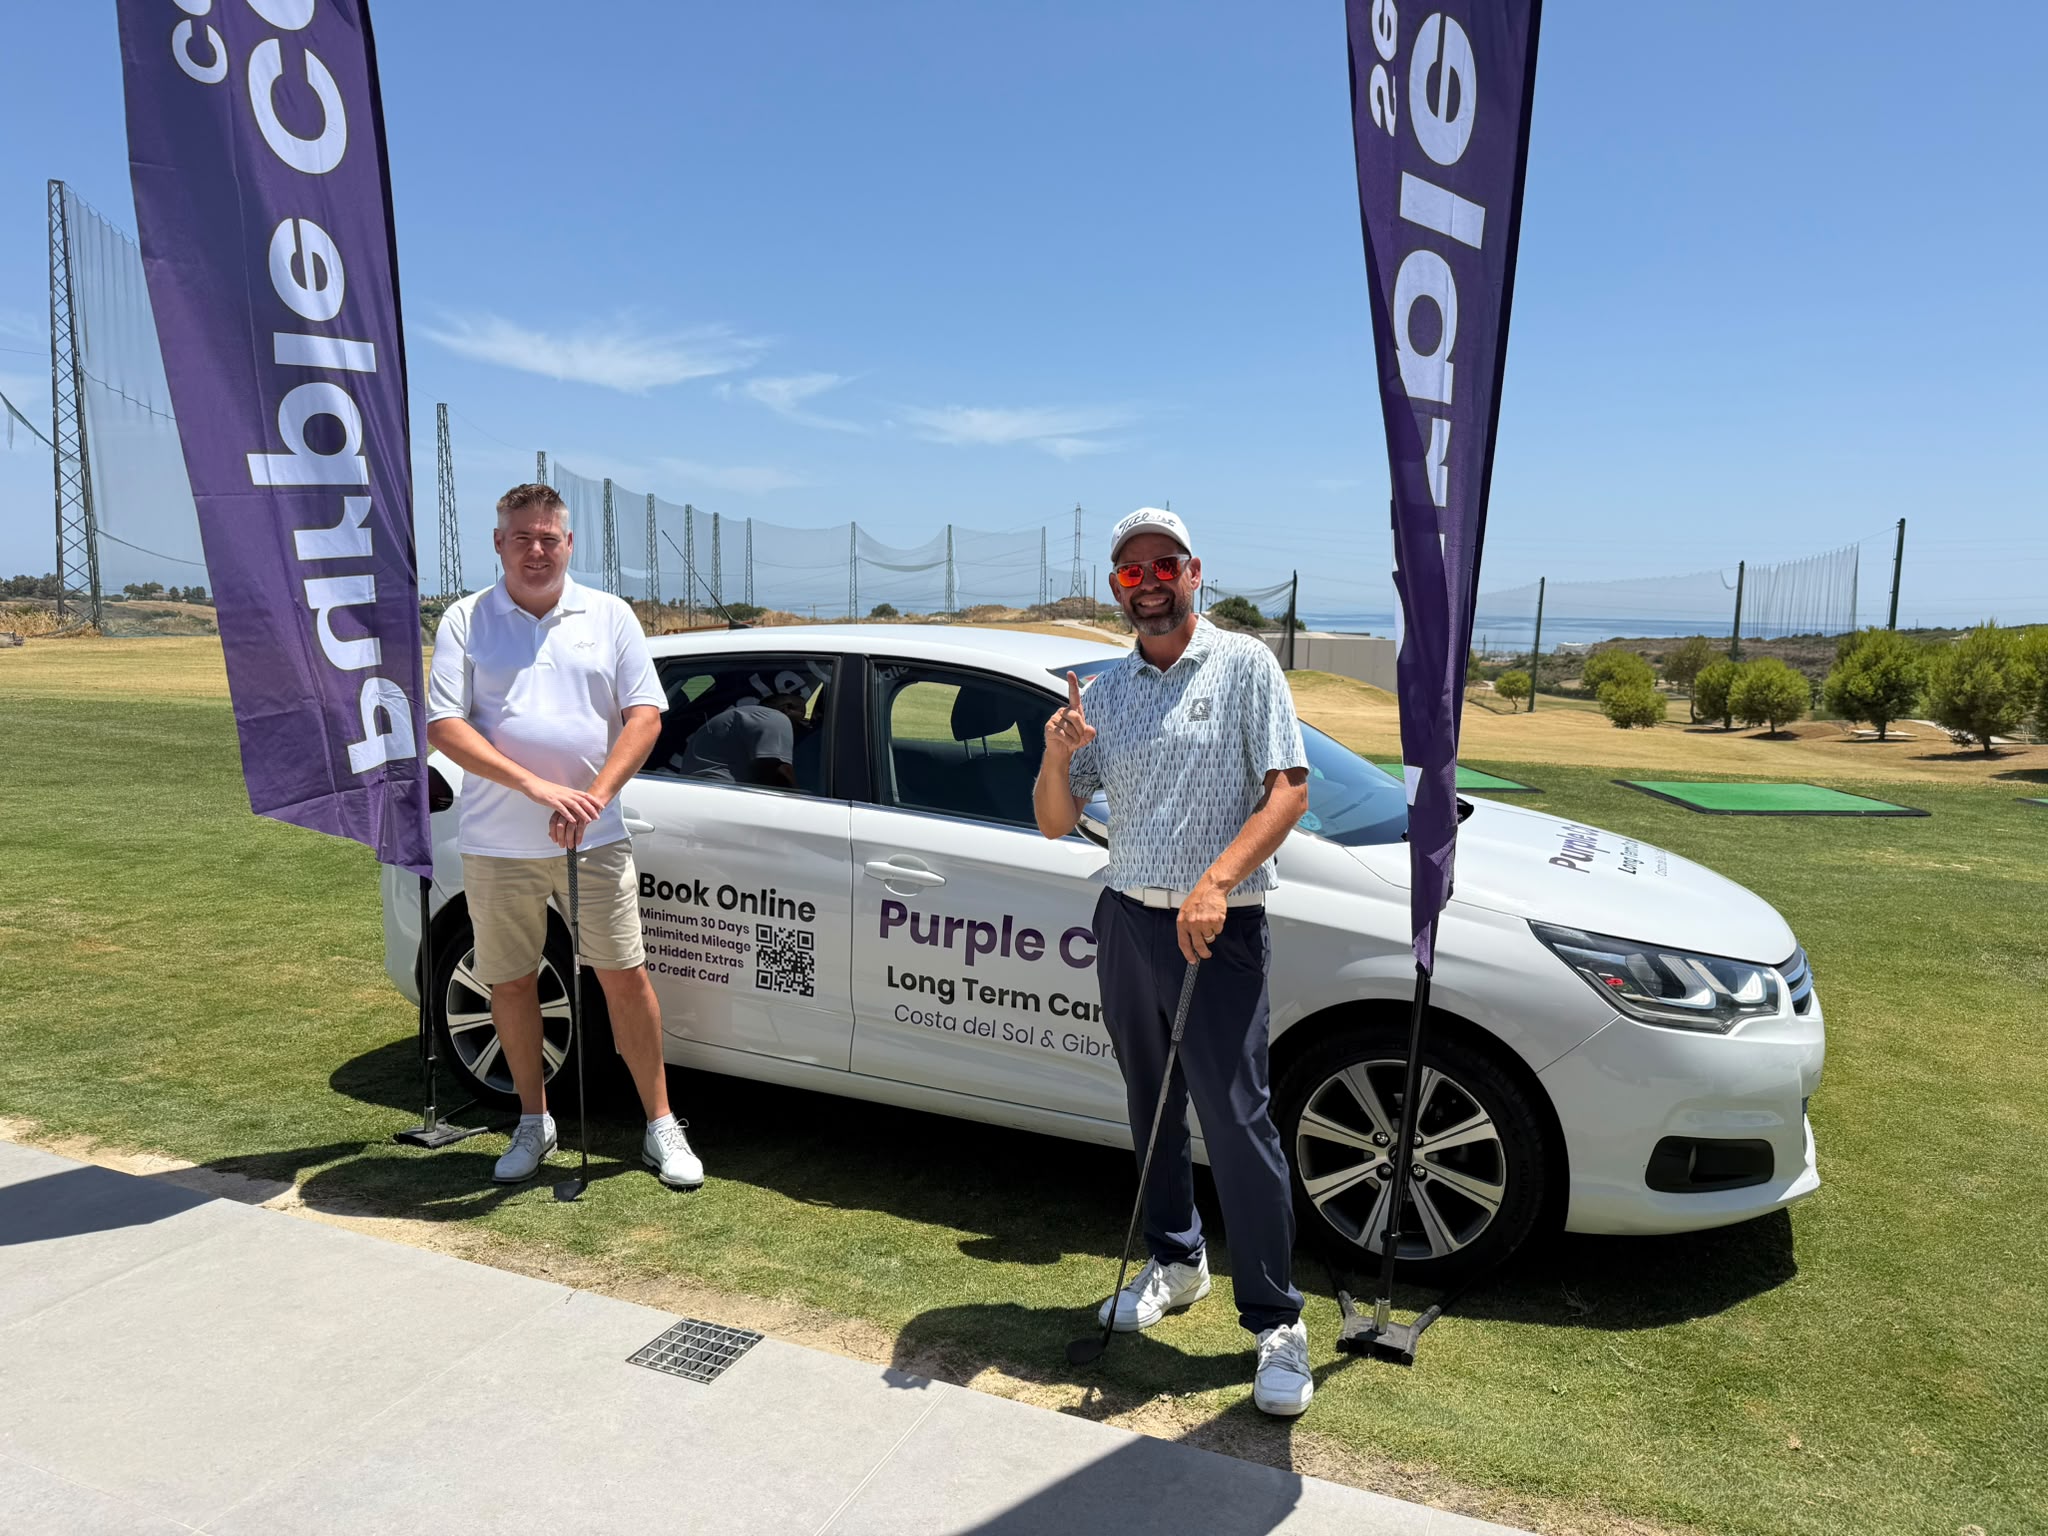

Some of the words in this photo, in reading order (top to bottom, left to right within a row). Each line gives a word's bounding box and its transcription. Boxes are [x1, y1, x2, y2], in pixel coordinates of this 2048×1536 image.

[639, 872, 710, 907] Book
[716, 884, 817, 924] Online
[640, 907, 698, 926] Minimum
[700, 916, 716, 929] 30
[718, 919, 750, 936] Days
[641, 925, 699, 943] Unlimited
[702, 935, 751, 954] Mileage
[879, 899, 1045, 967] Purple
[658, 962, 696, 978] Credit
[698, 969, 729, 984] Card
[659, 944, 703, 962] Hidden
[705, 952, 744, 968] Extras
[887, 965, 955, 1005] Long
[962, 978, 1041, 1012] Term
[1048, 993, 1103, 1023] Car
[894, 1004, 957, 1031] Costa
[963, 1016, 996, 1038] del
[1002, 1022, 1034, 1045] Sol
[1040, 1029, 1055, 1049] &
